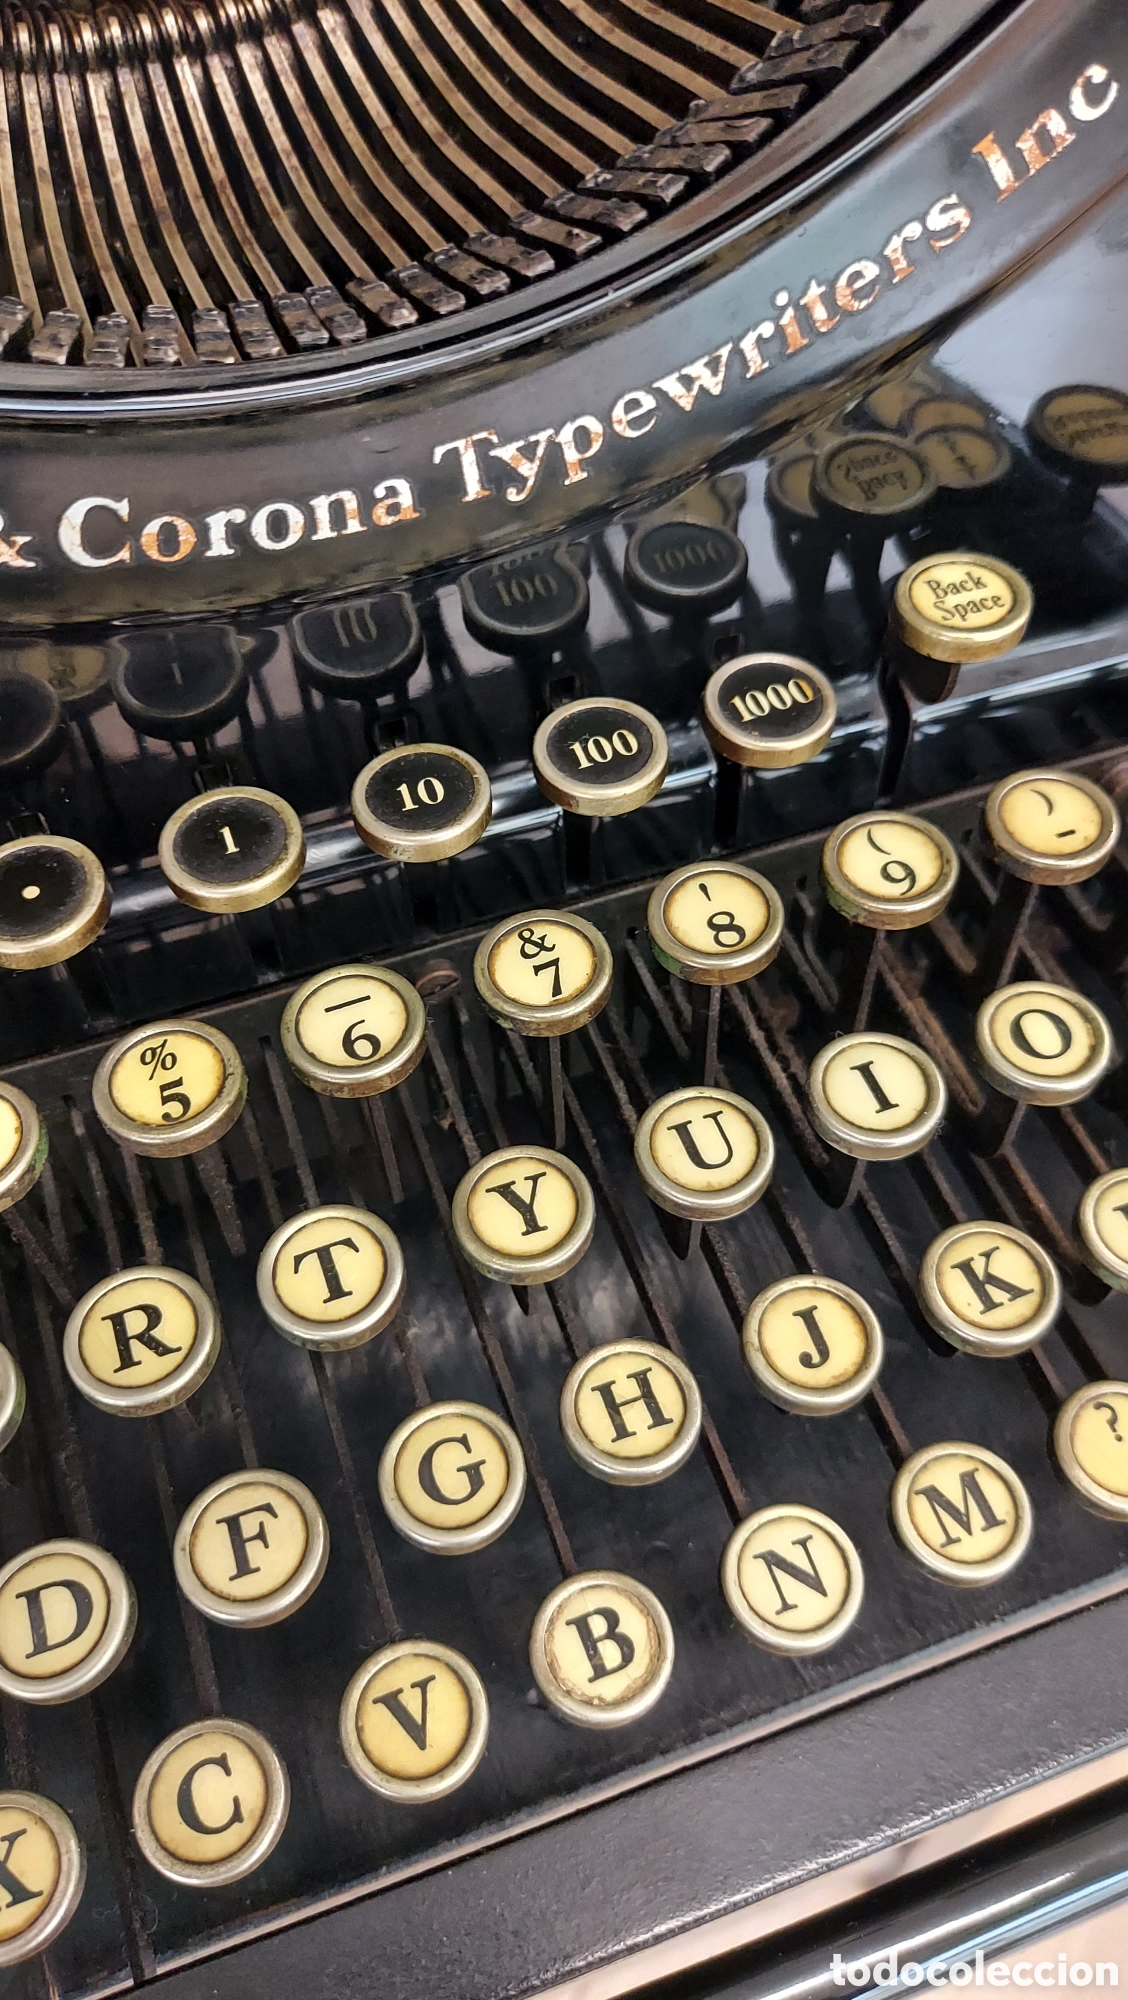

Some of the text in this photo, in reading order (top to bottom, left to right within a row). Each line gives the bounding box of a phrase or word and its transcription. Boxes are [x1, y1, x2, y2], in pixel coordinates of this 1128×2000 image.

[58, 478, 420, 568] Corona
[433, 193, 971, 503] Typewriters
[972, 63, 1119, 203] Inc
[923, 571, 988, 600] Back
[933, 595, 1006, 622] Space
[729, 678, 814, 723] 1000
[568, 729, 639, 770] 100
[396, 777, 445, 812] 10
[219, 826, 240, 855] 1
[879, 859, 918, 896] 9
[517, 927, 556, 960] &
[706, 910, 747, 949] 8
[532, 956, 563, 998] 7
[139, 1038, 178, 1081] %
[341, 1019, 382, 1062] 6
[1009, 1008, 1073, 1060] O
[159, 1075, 193, 1123] 5
[849, 1060, 900, 1114] I
[667, 1109, 734, 1170] U
[484, 1171, 549, 1237] Y
[293, 1237, 360, 1305] T
[950, 1245, 1035, 1315] K
[101, 1303, 183, 1374] R
[791, 1304, 831, 1370] J
[590, 1366, 674, 1444] H
[1093, 1400, 1123, 1443] ?
[417, 1432, 487, 1506] G
[914, 1466, 1007, 1549] M
[216, 1502, 279, 1582] F
[752, 1534, 829, 1616] N
[15, 1578, 94, 1660] D
[565, 1606, 636, 1684] B
[372, 1674, 437, 1752] V
[176, 1752, 245, 1836] C
